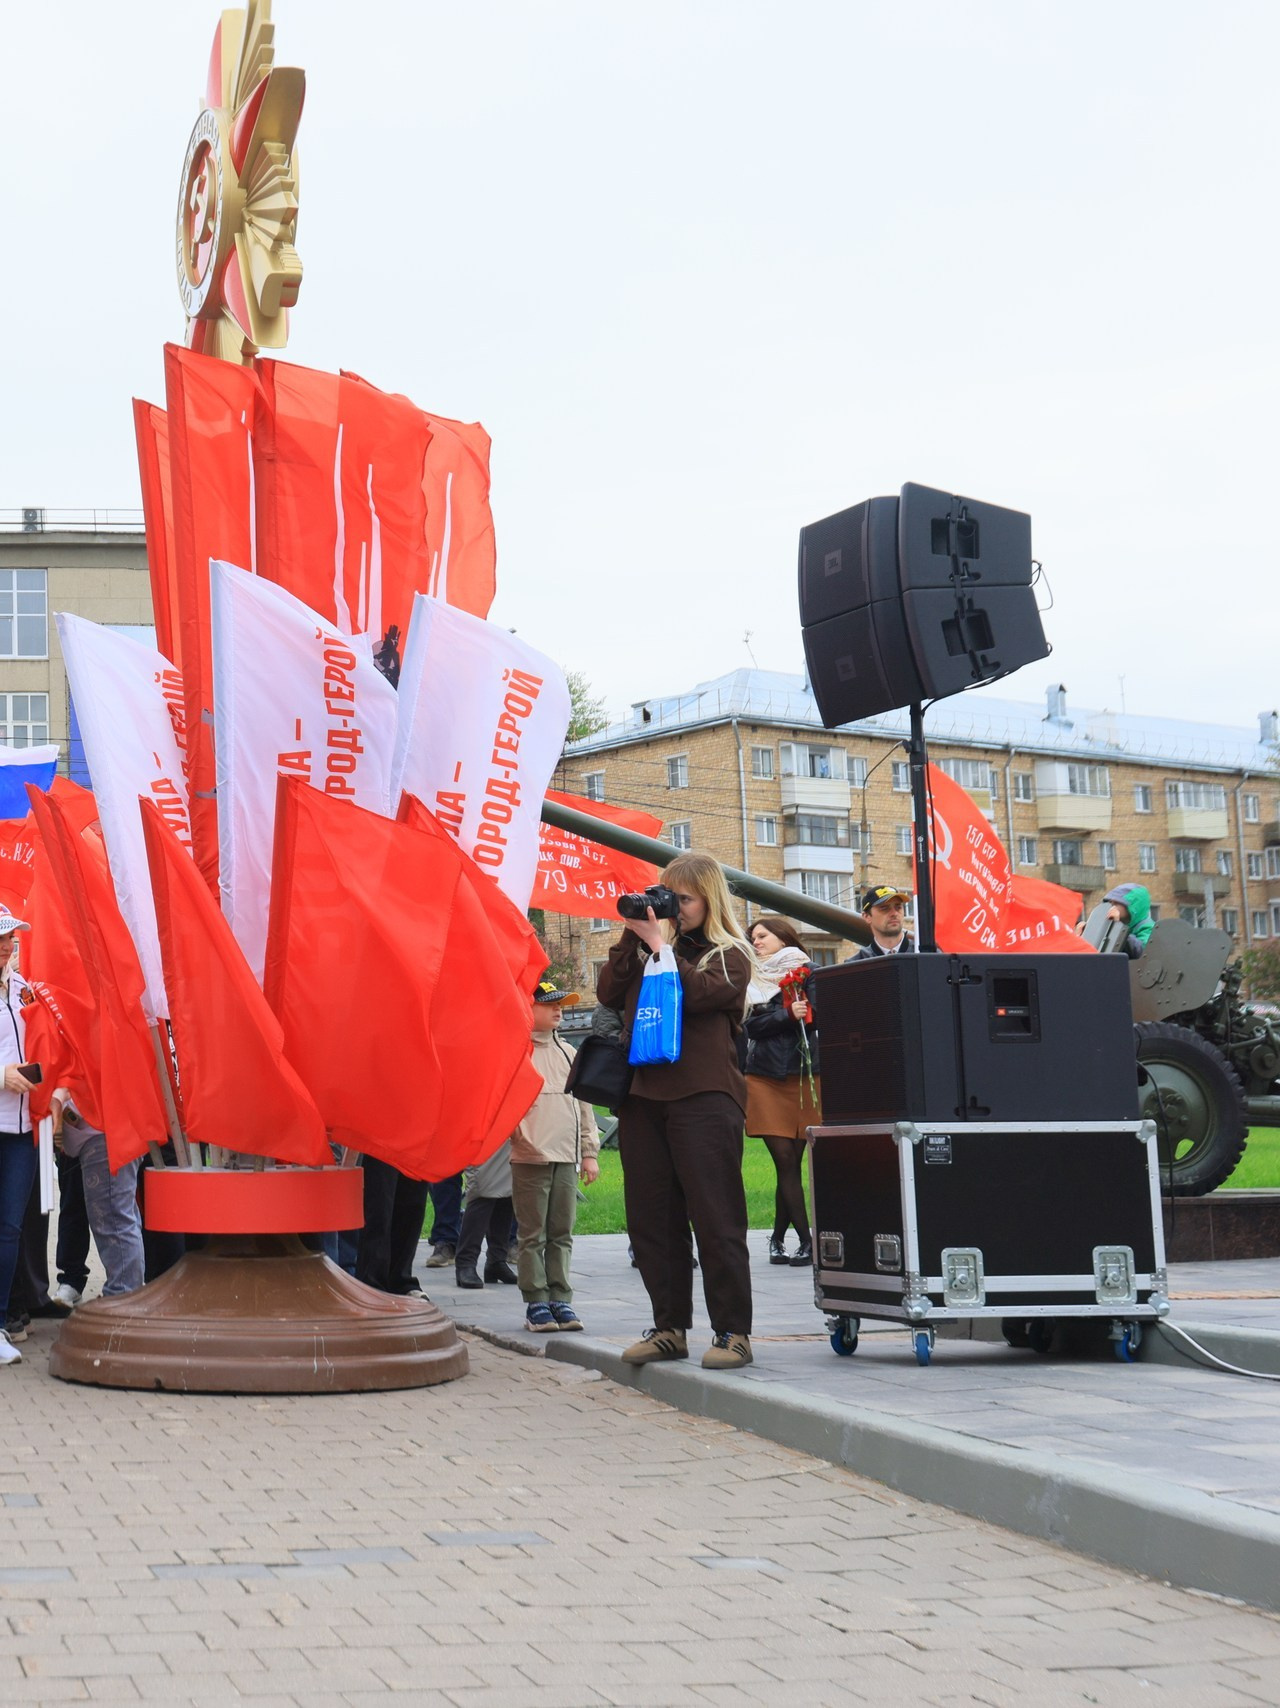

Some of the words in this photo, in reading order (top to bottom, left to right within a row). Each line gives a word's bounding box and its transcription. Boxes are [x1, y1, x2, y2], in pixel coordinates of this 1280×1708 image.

[965, 824, 984, 849] 150
[538, 868, 568, 893] 79
[962, 898, 987, 934] 79
